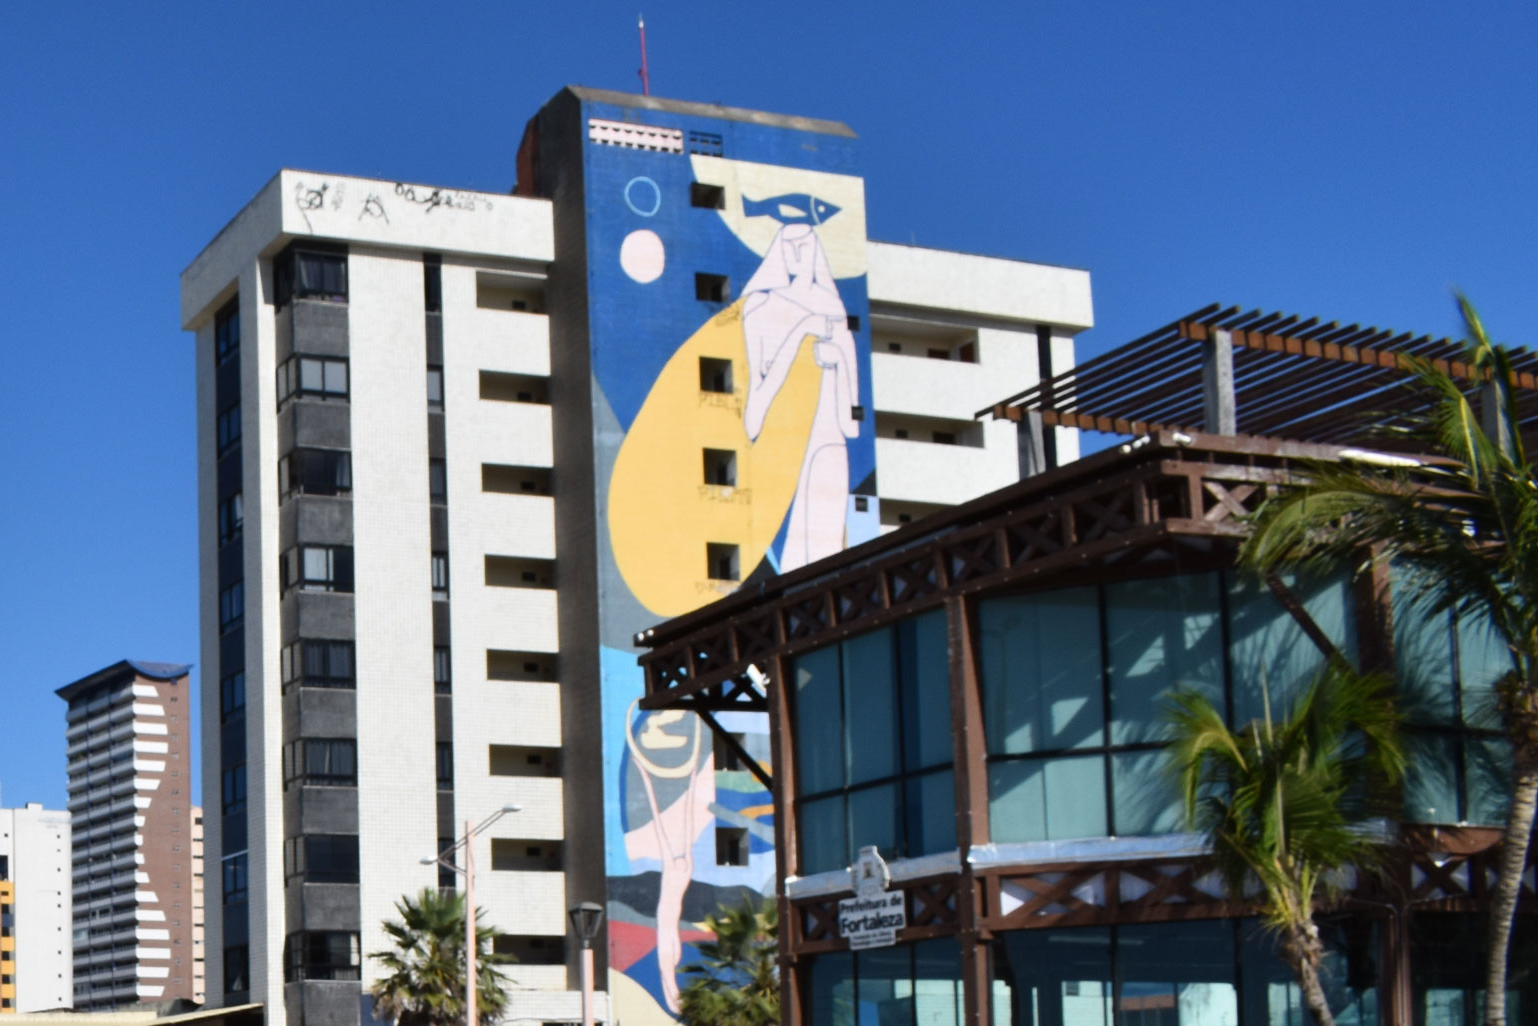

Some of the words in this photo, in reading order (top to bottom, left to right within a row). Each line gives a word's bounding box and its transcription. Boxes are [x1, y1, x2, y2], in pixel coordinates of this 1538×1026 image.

[840, 899, 887, 912] Prefeitura
[890, 893, 902, 906] de
[842, 911, 903, 934] Fortaleza
